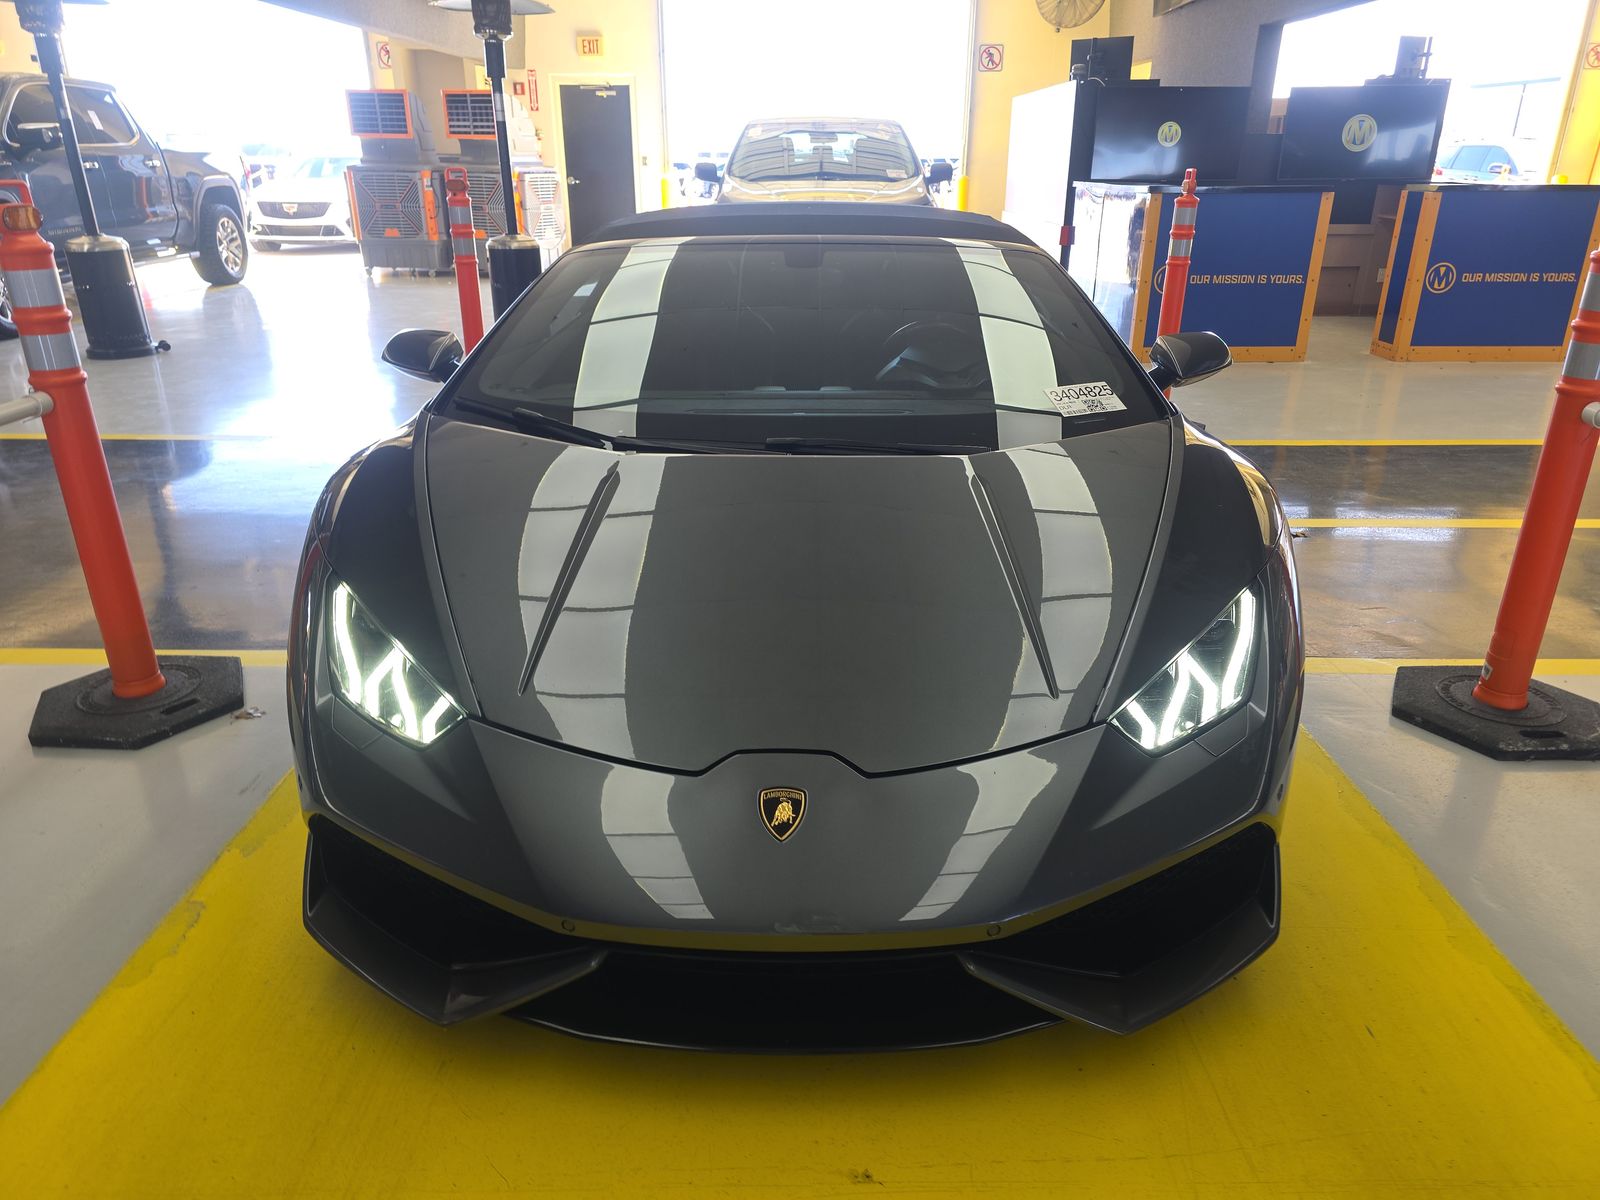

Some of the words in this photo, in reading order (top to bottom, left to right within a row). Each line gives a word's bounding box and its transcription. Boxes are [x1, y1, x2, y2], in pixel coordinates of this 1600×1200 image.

[582, 39, 599, 54] EXIT
[1190, 275, 1210, 284] OUR
[1212, 275, 1254, 284] MISSION
[1258, 275, 1268, 284] IS
[1270, 275, 1304, 284] YOURS.
[1462, 273, 1483, 282] OUR
[1484, 273, 1527, 282] MISSION
[1530, 273, 1540, 282] IS
[1542, 273, 1577, 282] YOURS.
[1050, 385, 1114, 401] 3404825
[764, 791, 802, 800] LAMBORGHINI
